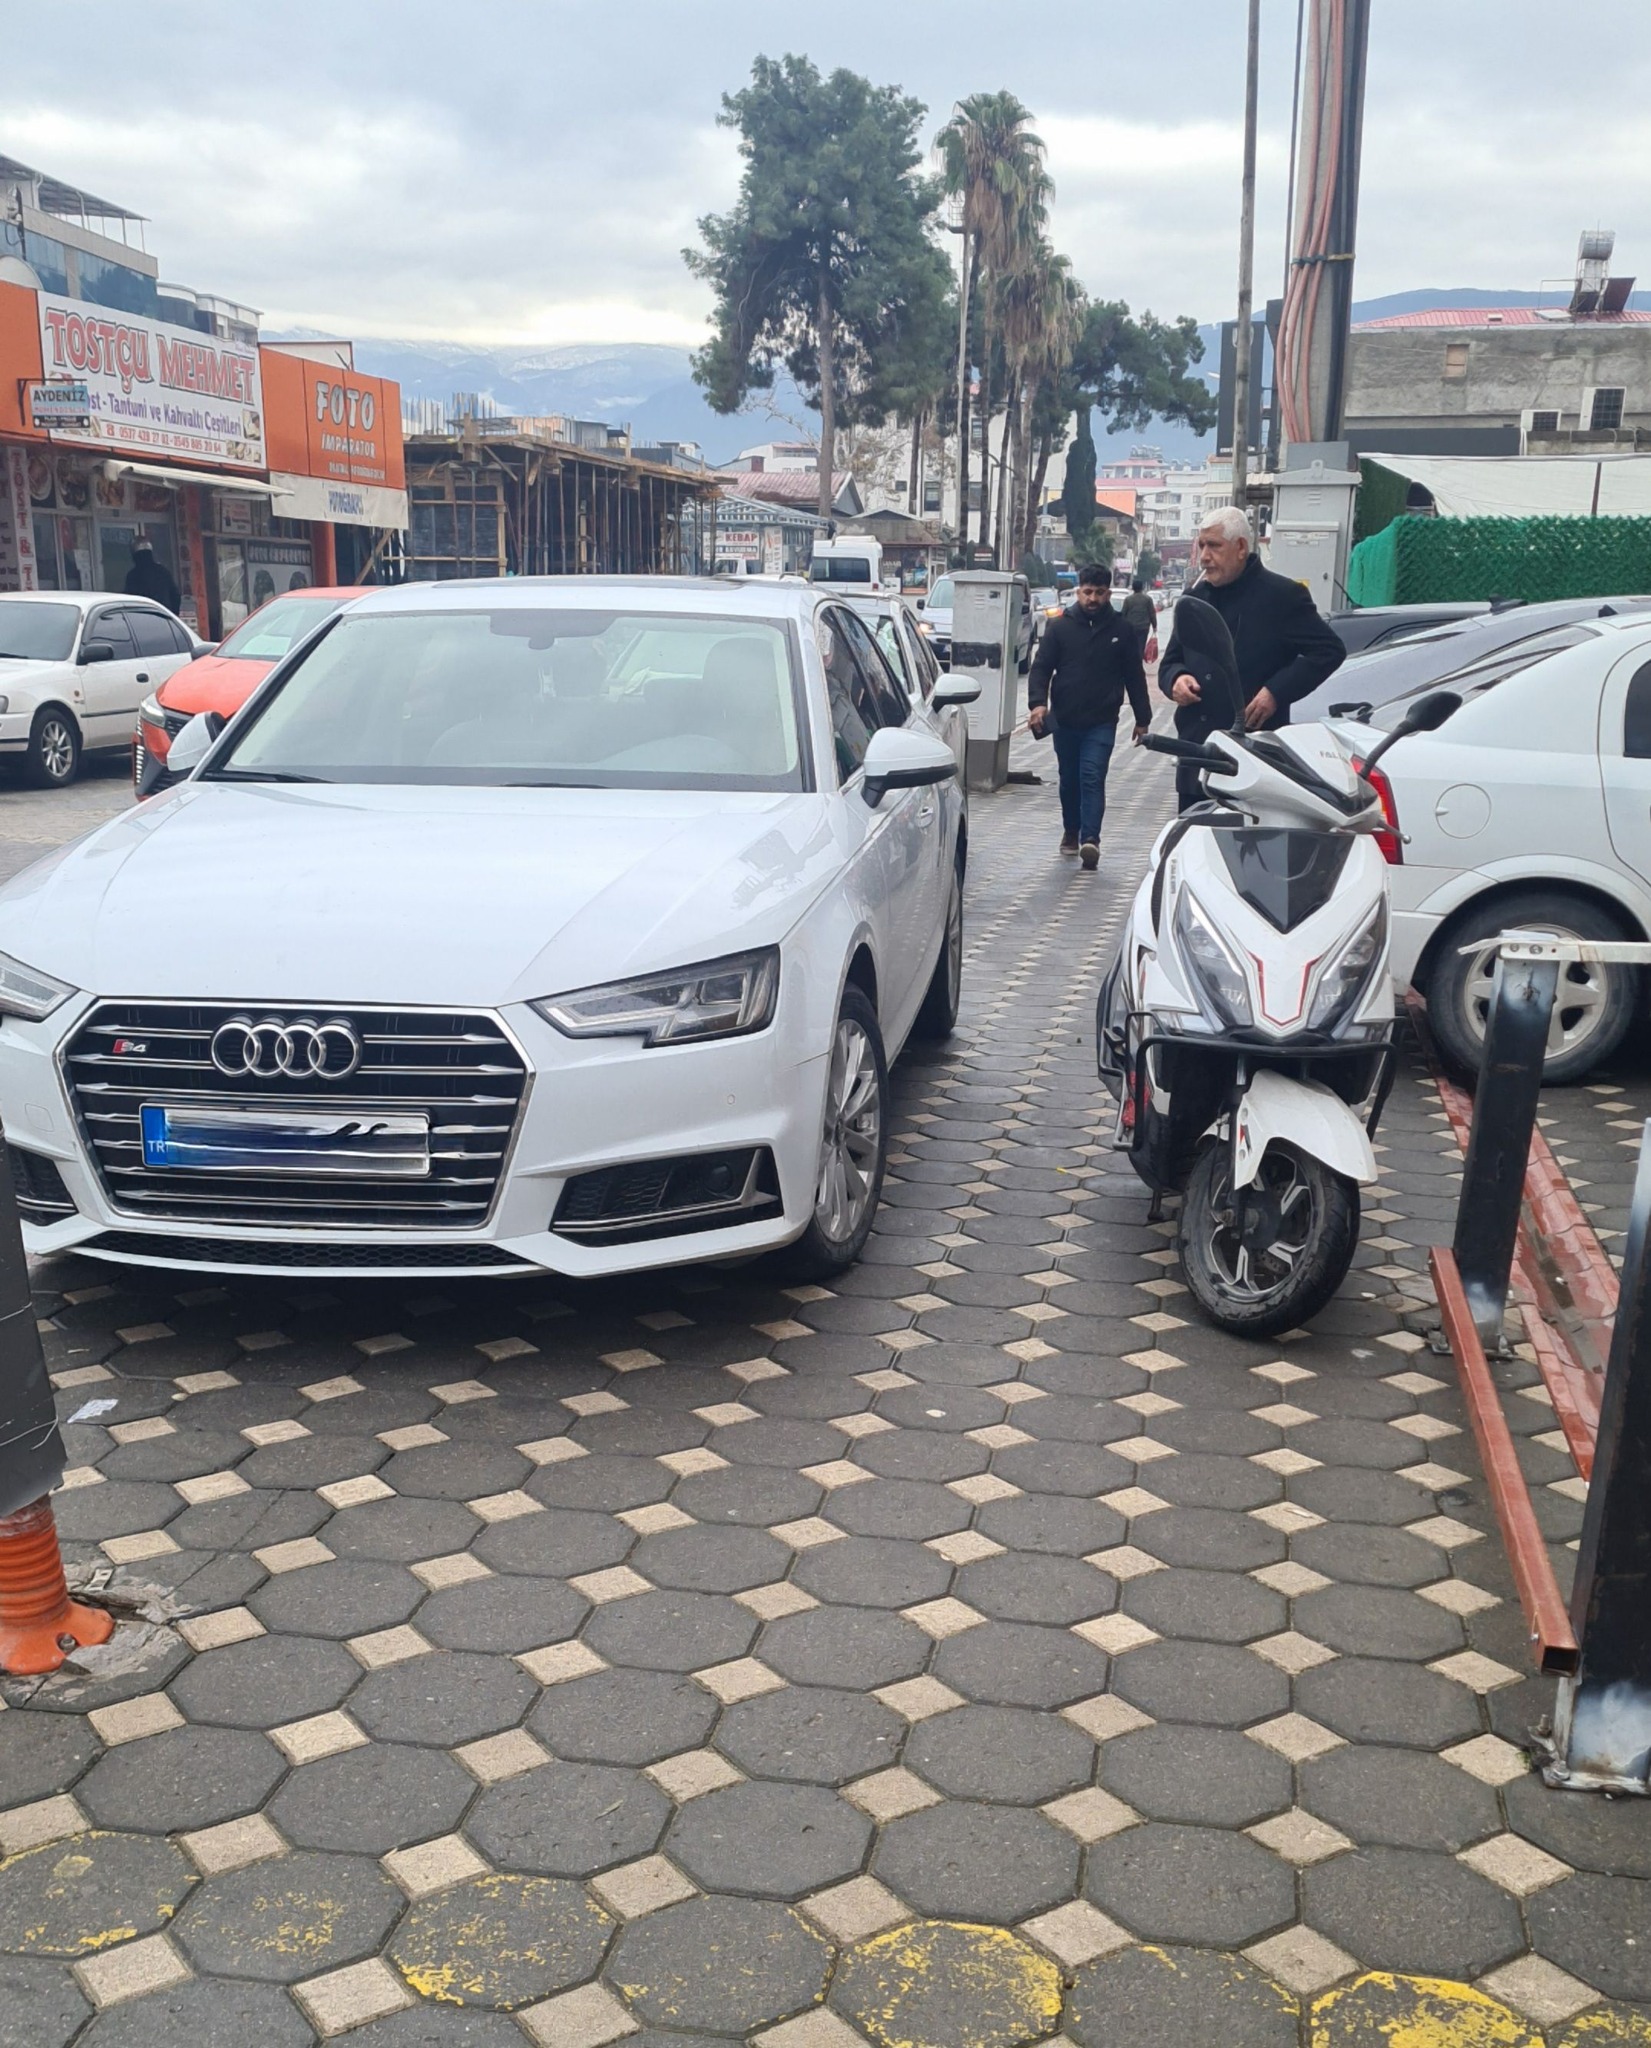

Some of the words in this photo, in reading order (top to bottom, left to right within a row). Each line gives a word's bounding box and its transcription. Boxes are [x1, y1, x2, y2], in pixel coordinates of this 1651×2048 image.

[45, 306, 154, 394] TOSTÇU
[156, 333, 255, 406] MEHMET
[107, 392, 147, 418] Tantuni
[150, 405, 161, 422] ve
[316, 381, 375, 431] FOTO
[725, 533, 758, 542] KEBAP
[121, 1040, 147, 1054] S4
[148, 1140, 165, 1153] TR
